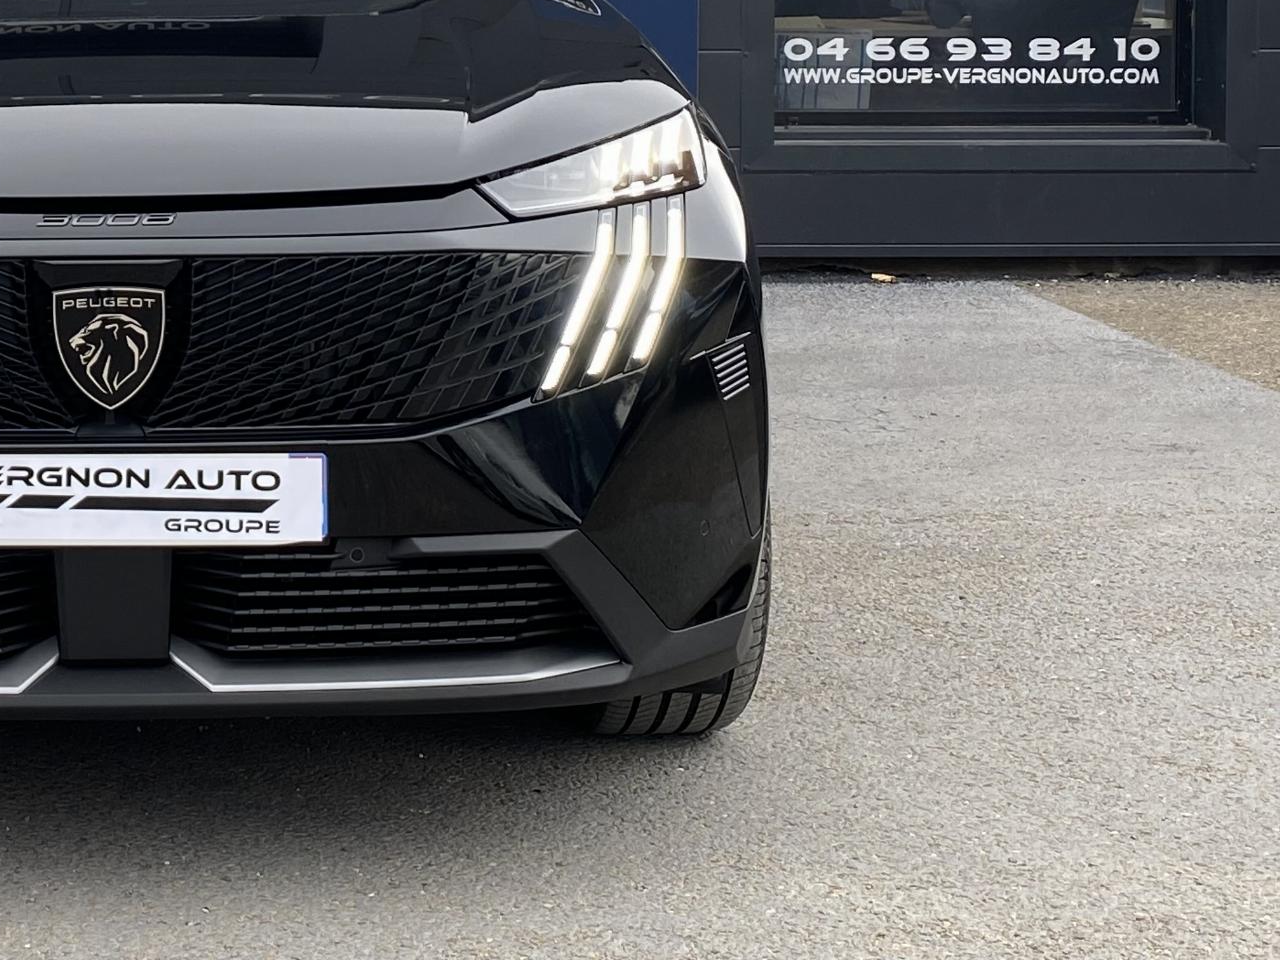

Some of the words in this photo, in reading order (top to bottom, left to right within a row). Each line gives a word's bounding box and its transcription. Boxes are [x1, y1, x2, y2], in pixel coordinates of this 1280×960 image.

[783, 37, 850, 62] 04
[865, 37, 930, 62] 66
[946, 37, 1013, 62] 93
[1028, 37, 1097, 62] 84
[1113, 37, 1161, 62] 10
[783, 67, 1161, 85] WWW.GROUPE-VERGNONAUTO.COM
[35, 213, 178, 228] 3008
[62, 296, 156, 310] PEUGEOT
[164, 469, 281, 492] AUTO
[164, 517, 281, 534] GROUPE
